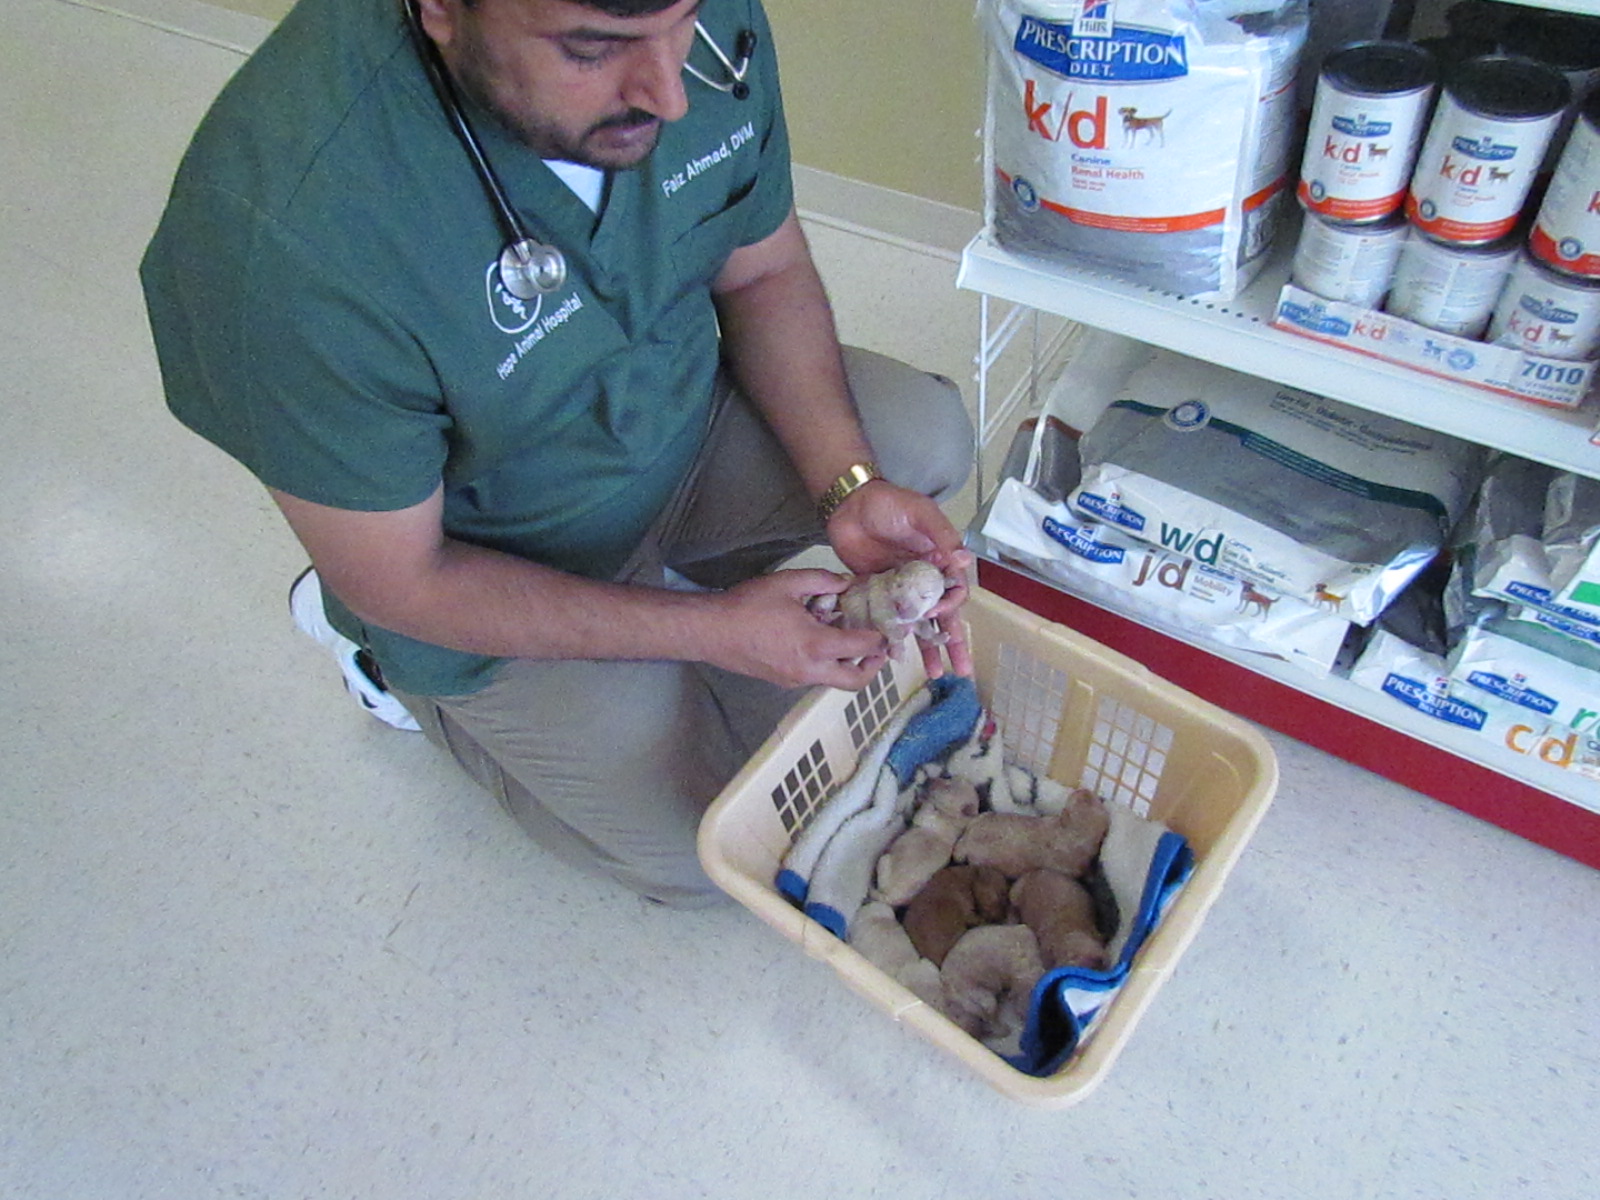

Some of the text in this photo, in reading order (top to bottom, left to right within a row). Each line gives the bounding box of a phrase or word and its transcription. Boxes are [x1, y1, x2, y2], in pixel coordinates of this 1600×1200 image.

[1021, 20, 1185, 66] PRESCRIPTION
[1024, 79, 1107, 149] k/d
[661, 172, 687, 198] Faiz
[730, 121, 755, 150] DVM
[1071, 153, 1111, 165] Canine
[1324, 134, 1362, 164] k/d
[1071, 166, 1145, 180] Renal Health
[1440, 154, 1482, 186] k/d
[496, 291, 584, 381] Hope Animal Hospital
[1522, 361, 1585, 385] 7010
[1080, 494, 1142, 526] PRESCRIPTION
[1045, 518, 1121, 560] PRESCRIPTION
[1161, 522, 1225, 565] w/d
[1132, 548, 1193, 591] j/d
[1194, 575, 1234, 597] Mobility
[1199, 564, 1236, 581] Canine
[1386, 676, 1483, 724] PRESCRIPTION
[1471, 672, 1553, 710] PRESCRIPTION
[1505, 724, 1579, 769] c/d
